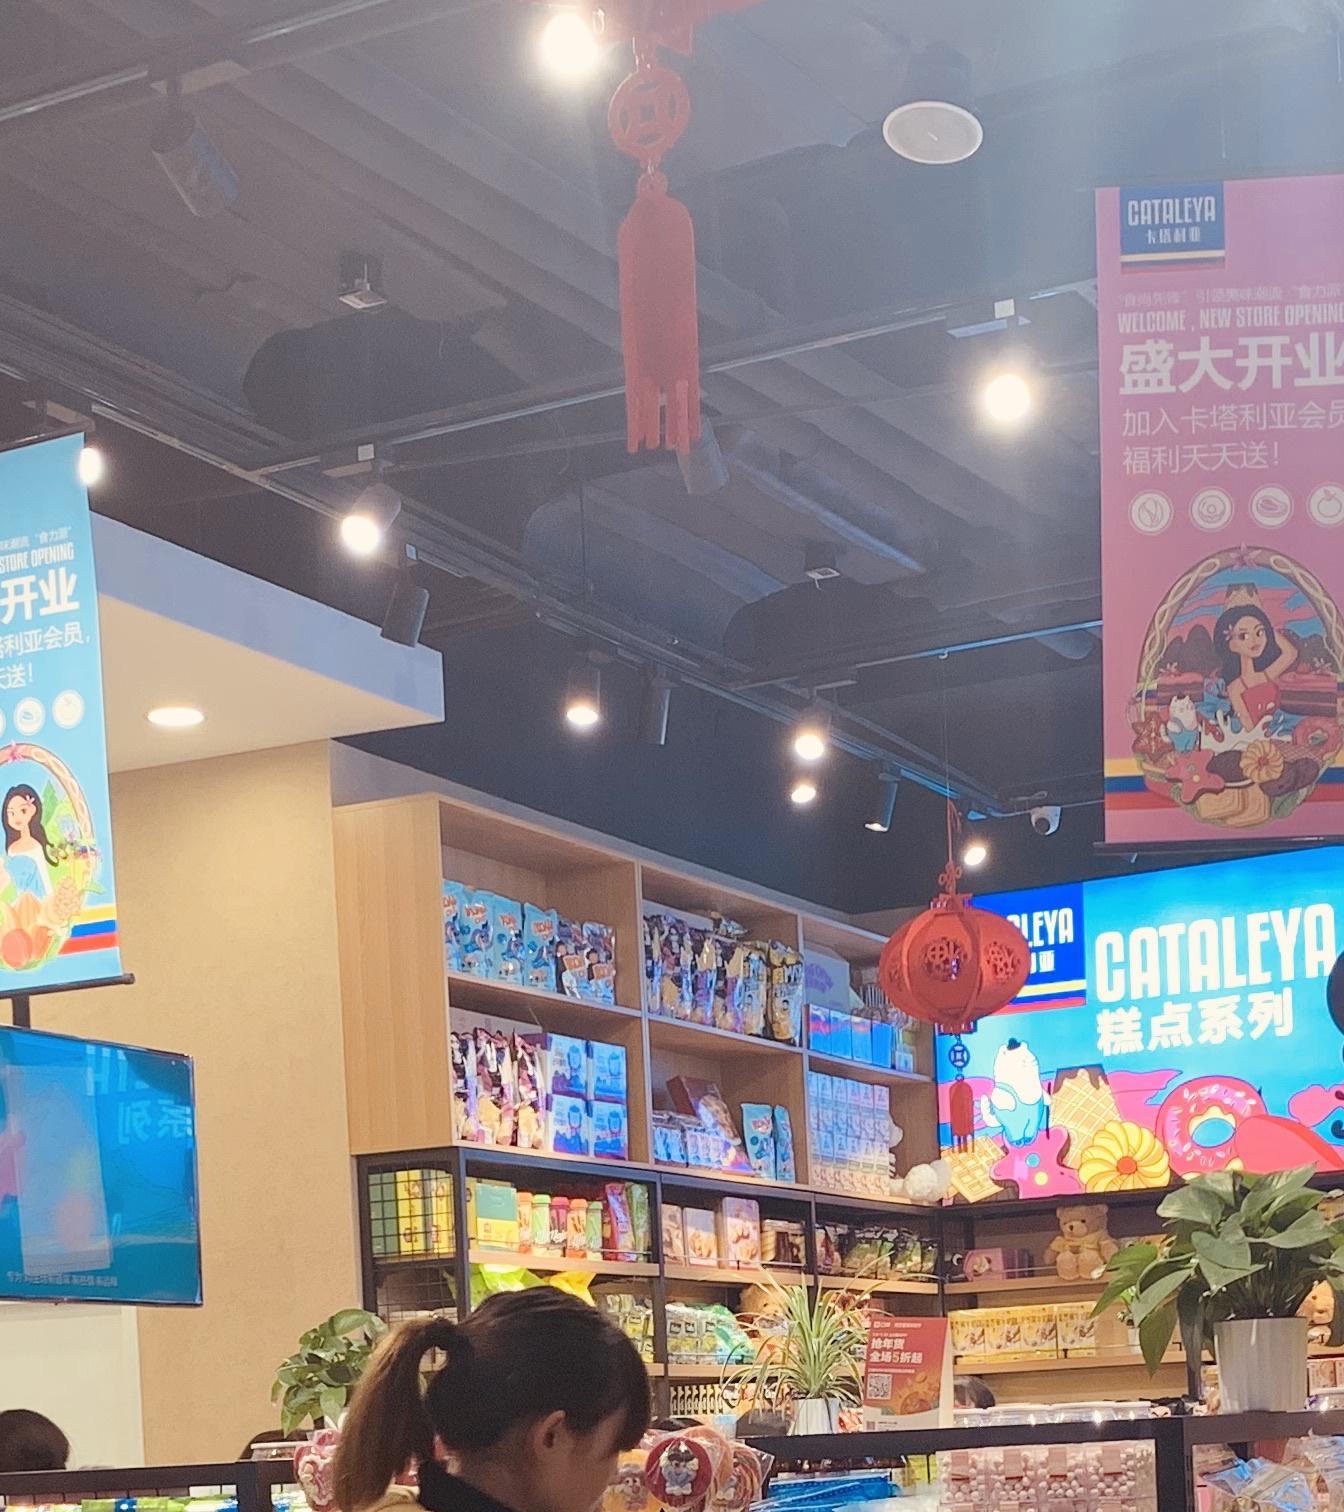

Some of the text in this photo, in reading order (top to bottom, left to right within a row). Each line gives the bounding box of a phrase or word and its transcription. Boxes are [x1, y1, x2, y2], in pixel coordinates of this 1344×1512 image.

[1127, 195, 1216, 226] CATALEYA
[1199, 307, 1231, 329] NEW
[1236, 304, 1281, 327] STORE
[0, 550, 29, 574] STORE
[31, 542, 74, 567] OPENING
[1095, 903, 1337, 1003] CATALEYA
[1096, 985, 1294, 1057] 糕点系列
